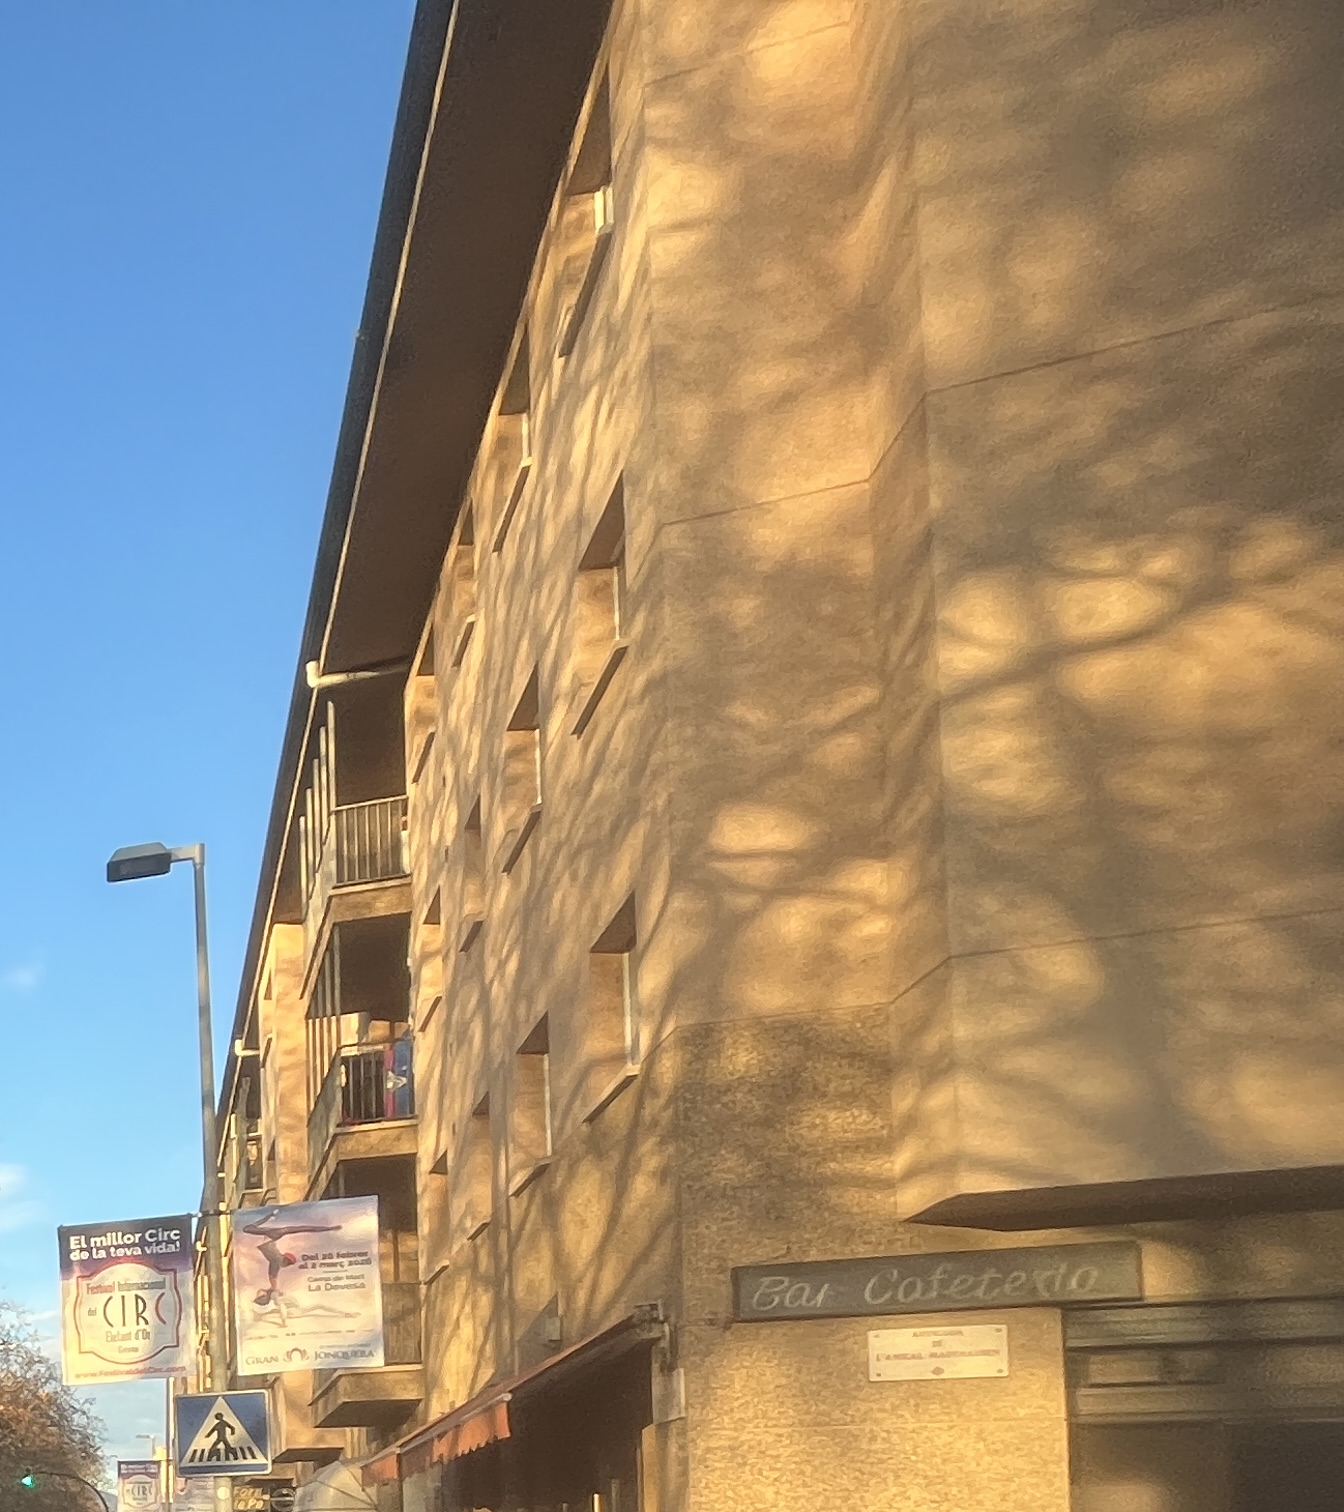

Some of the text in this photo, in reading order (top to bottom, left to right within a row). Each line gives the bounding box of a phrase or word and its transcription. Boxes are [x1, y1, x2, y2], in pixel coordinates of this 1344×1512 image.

[69, 1227, 181, 1249] El millor Circ
[69, 1240, 181, 1261] de la teva vida!
[103, 1291, 168, 1328] CIRC
